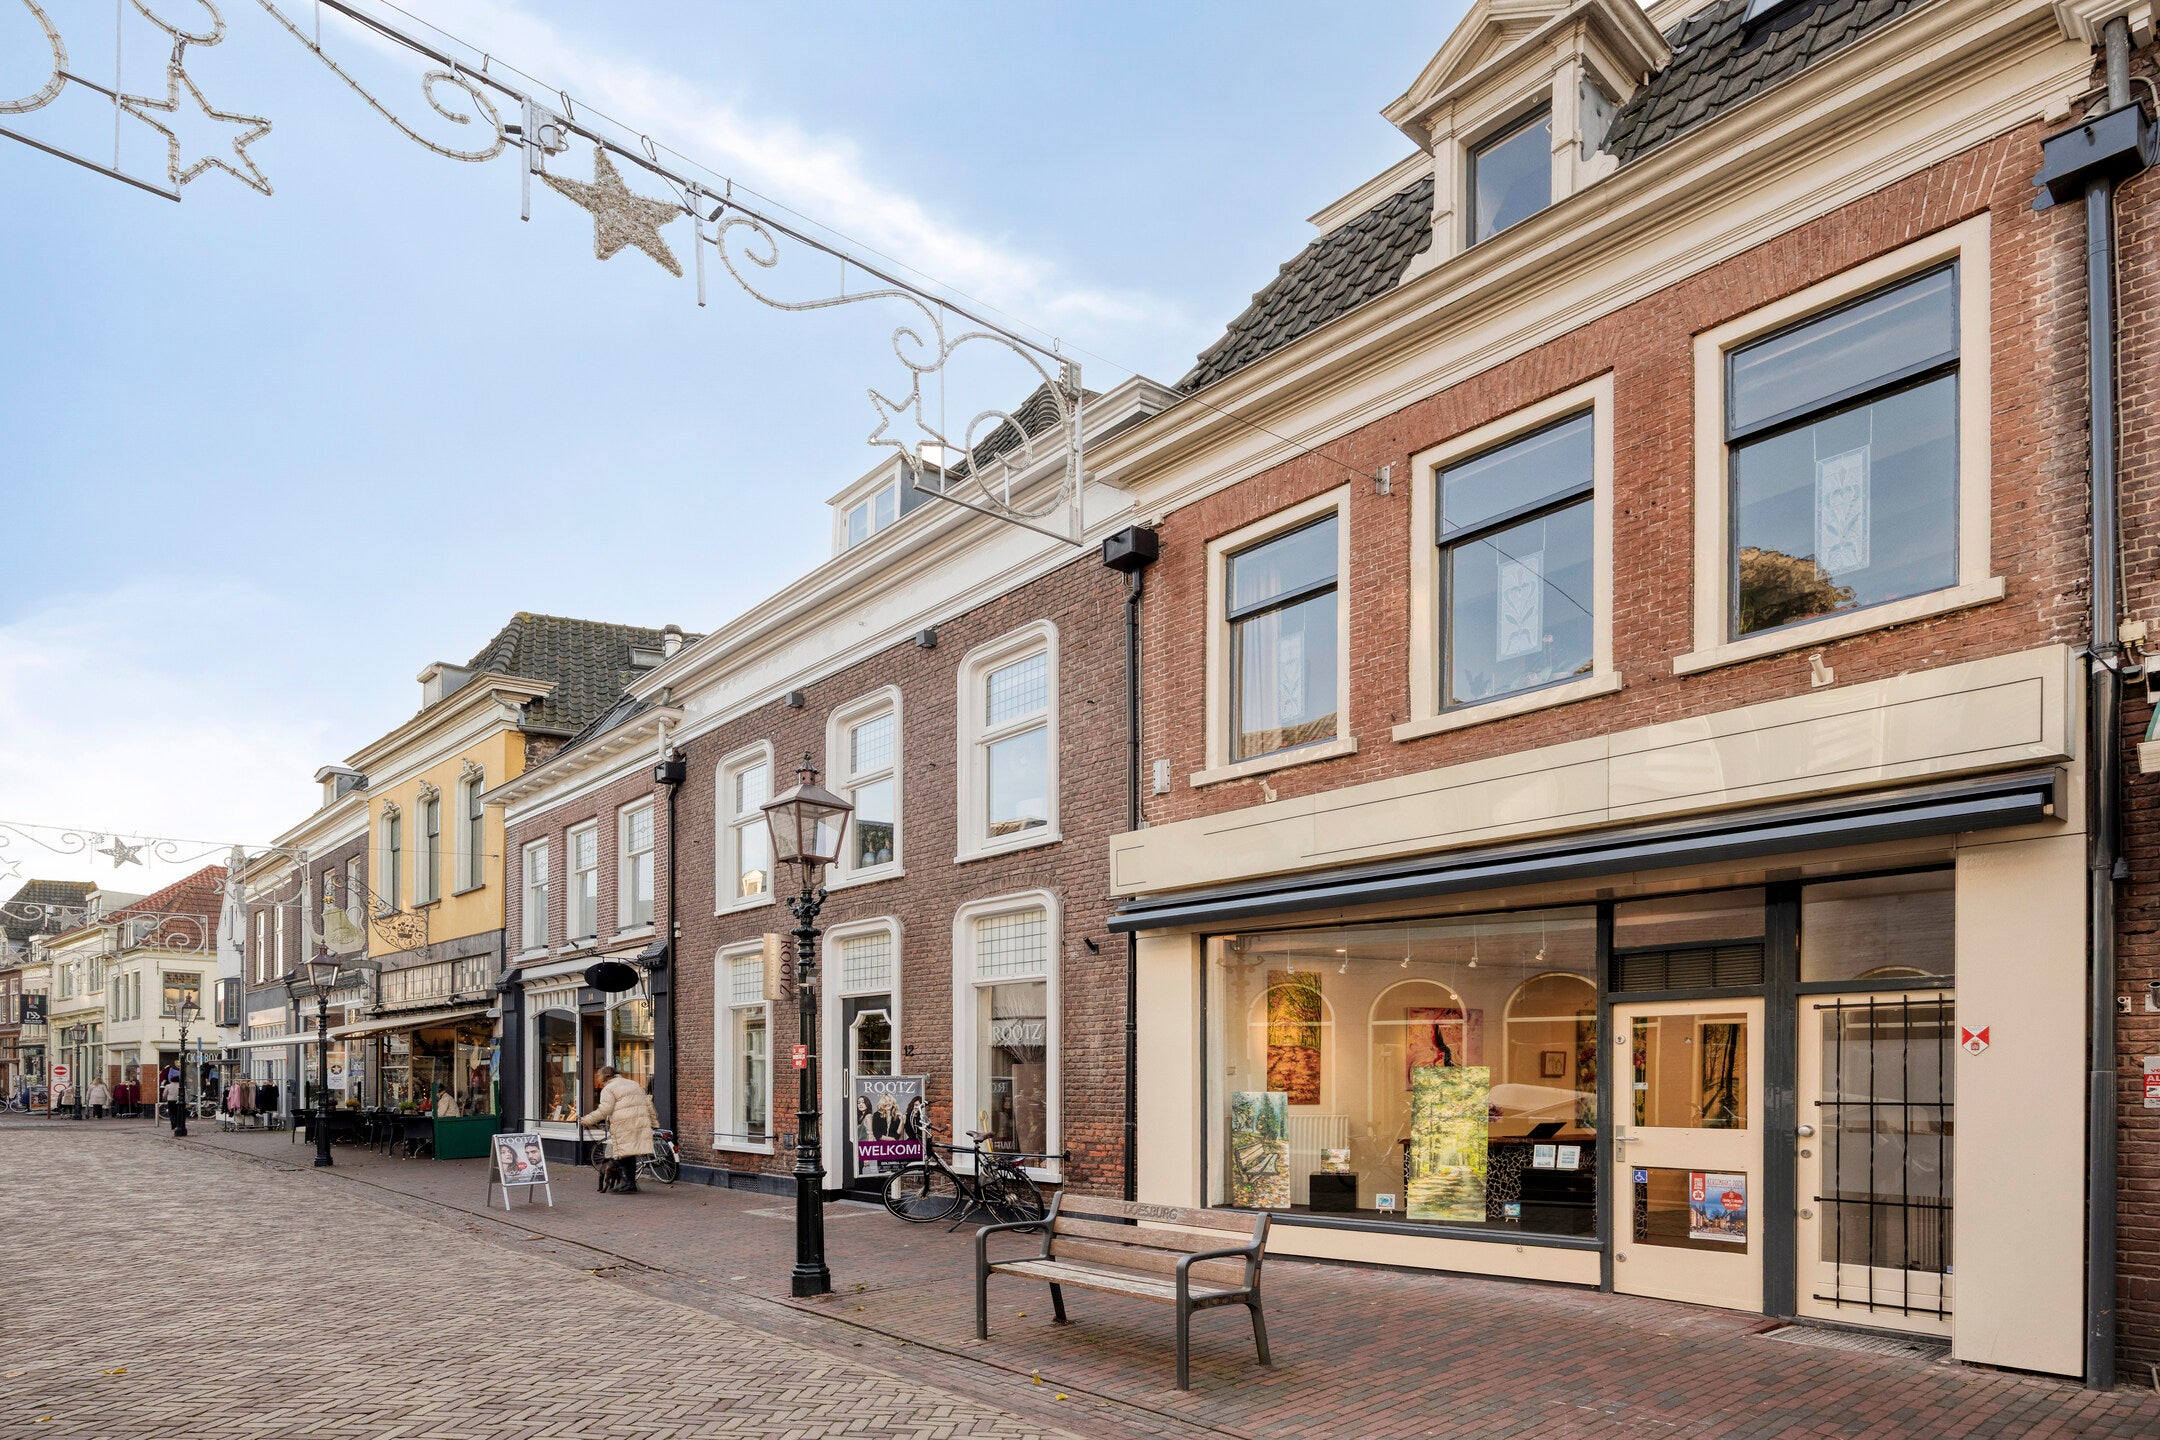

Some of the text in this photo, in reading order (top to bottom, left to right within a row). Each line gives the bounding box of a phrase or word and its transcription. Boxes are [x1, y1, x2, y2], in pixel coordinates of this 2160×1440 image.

[779, 940, 792, 995] ROOTZ
[992, 1023, 1043, 1042] ROOTZ
[904, 1045, 914, 1056] 12
[204, 1052, 219, 1063] BOX
[863, 1081, 915, 1095] ROOTZ
[499, 1136, 536, 1144] ROOTZ
[858, 1144, 921, 1156] WELKOM!
[1123, 1204, 1178, 1220] DOESBURG
